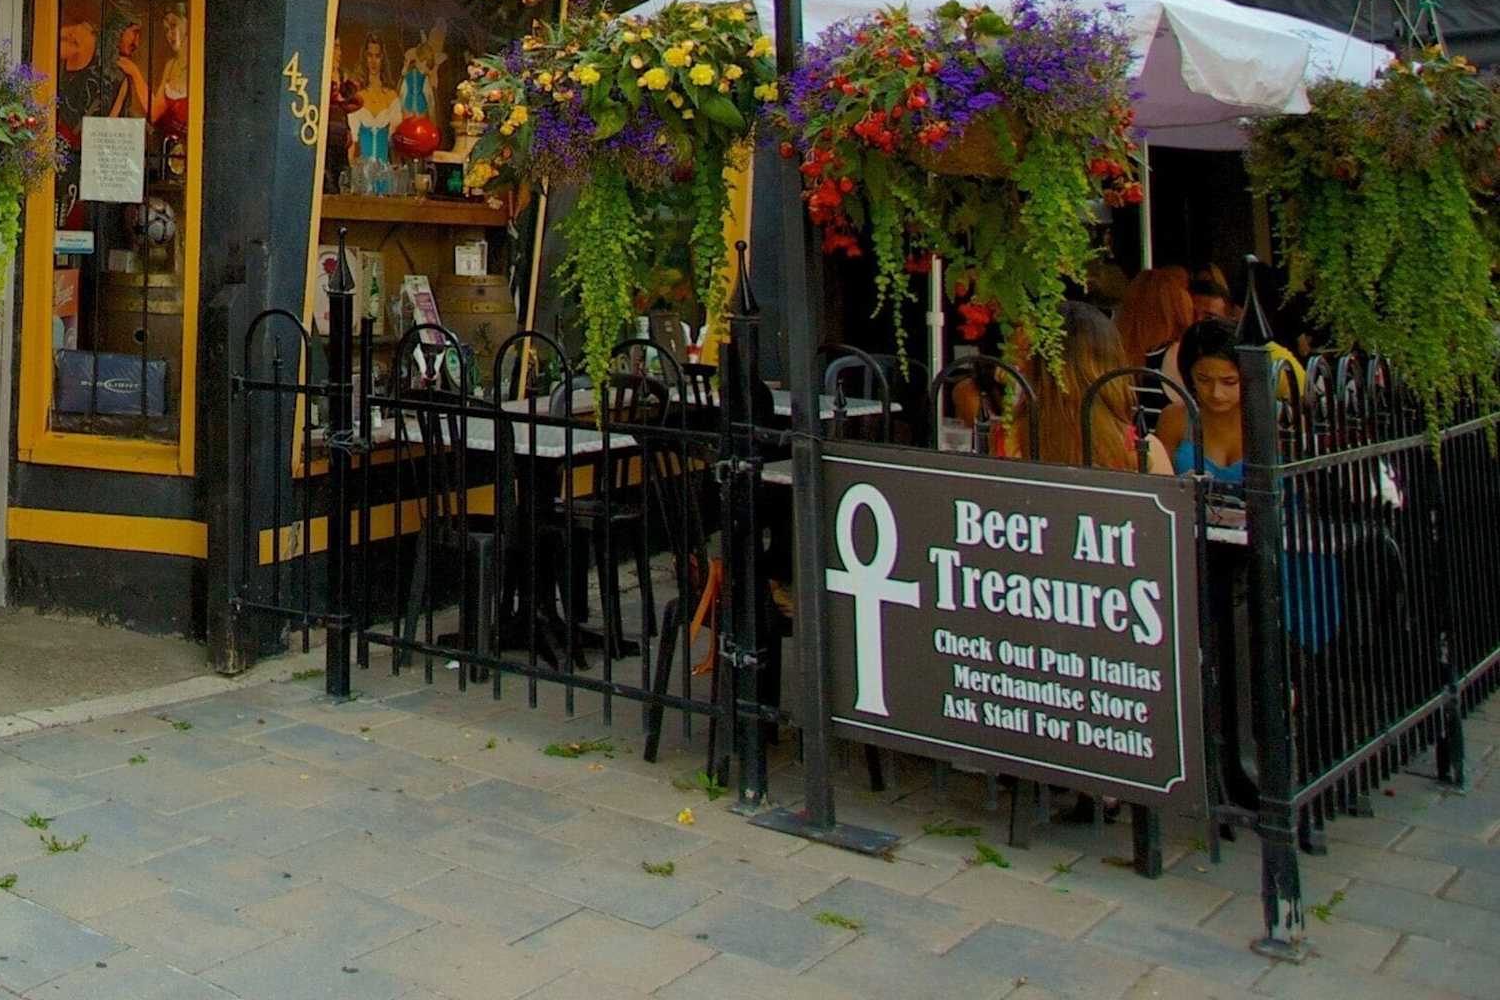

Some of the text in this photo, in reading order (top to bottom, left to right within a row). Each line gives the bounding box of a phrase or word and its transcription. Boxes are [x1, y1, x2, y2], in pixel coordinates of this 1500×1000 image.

[282, 51, 319, 145] 438
[954, 500, 1135, 567] Beer Art
[934, 629, 1163, 692] Check Out Pub Italias
[943, 694, 1154, 759] Ask Staff For Details
[953, 664, 1149, 724] Merchandise Store
